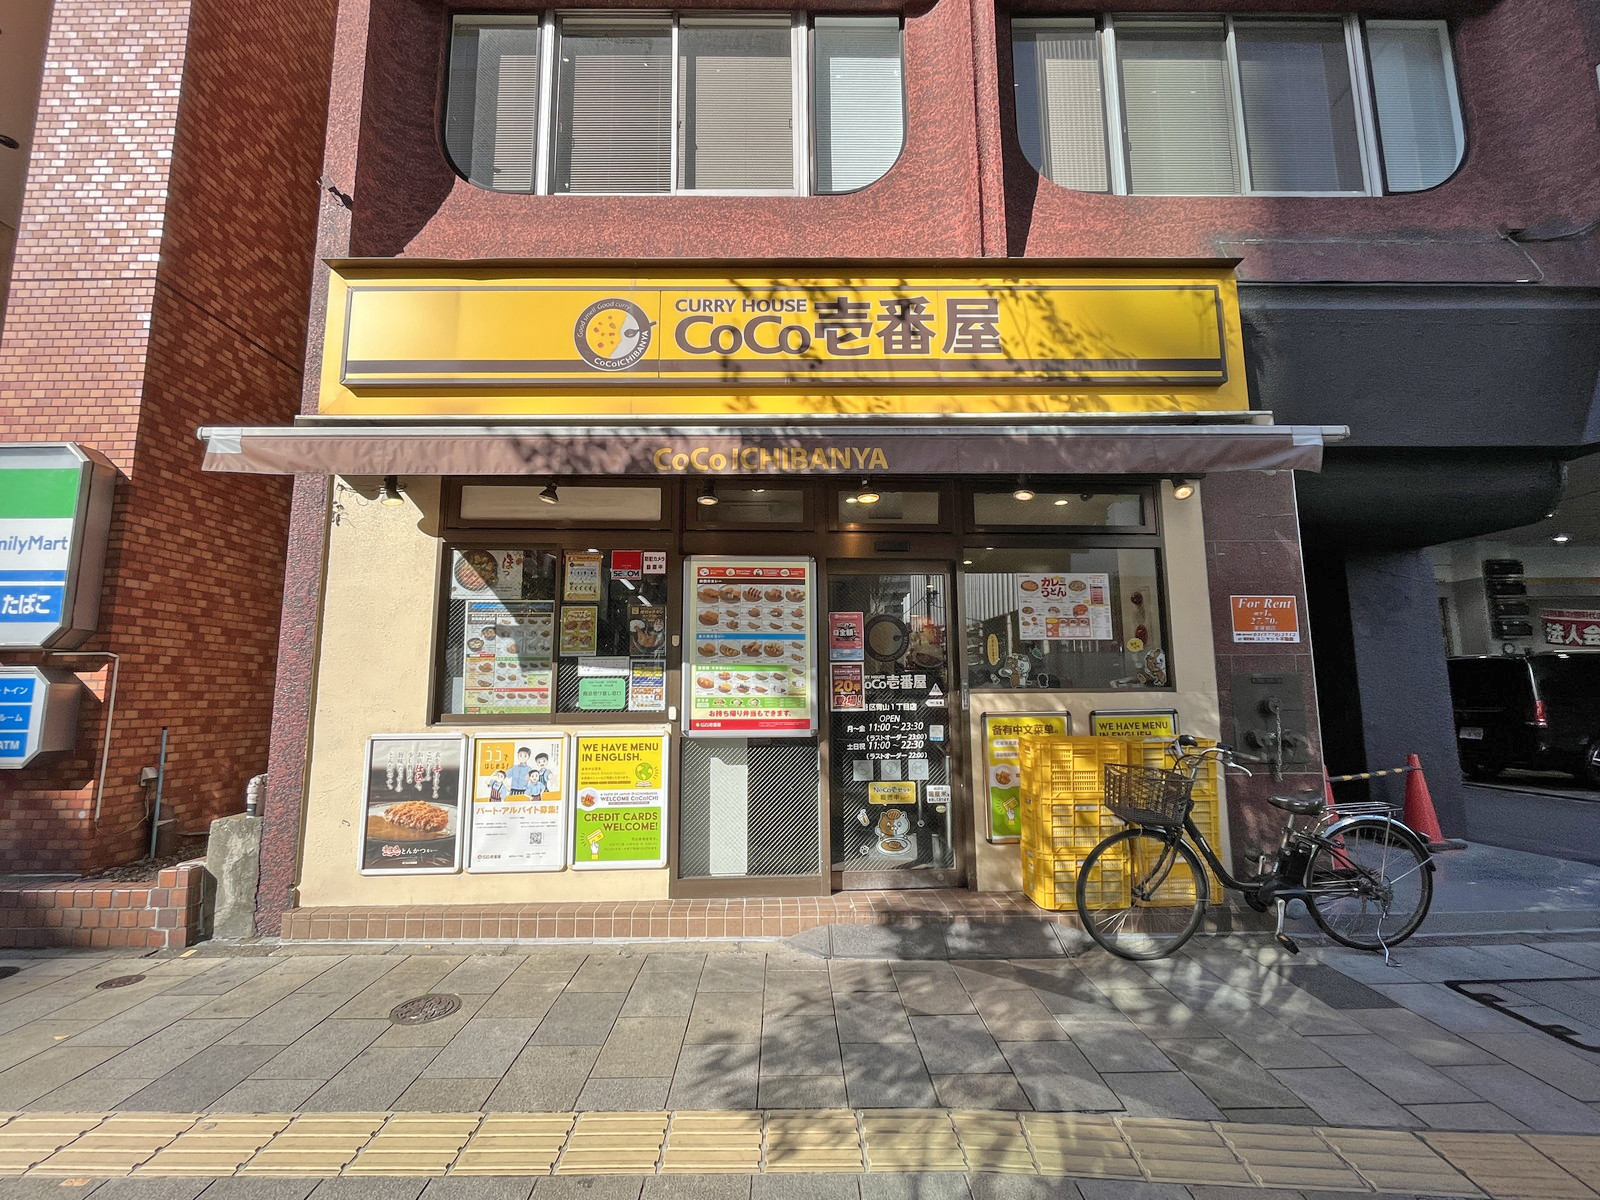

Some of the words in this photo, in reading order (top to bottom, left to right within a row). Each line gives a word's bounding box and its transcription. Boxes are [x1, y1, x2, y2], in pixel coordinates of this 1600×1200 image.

[675, 299, 737, 313] CURRY
[742, 299, 807, 313] HOUSE
[577, 321, 586, 338] Good
[597, 301, 615, 311] Good
[615, 302, 632, 311] curry
[673, 296, 1003, 356] CoCo壱番屋
[654, 447, 723, 473] CoCo
[731, 446, 889, 472] ICHIBANYA
[1041, 576, 1067, 587] カレー
[1041, 587, 1067, 598] うどん
[2, 593, 52, 615] たばこ
[1239, 598, 1261, 609] For
[1264, 598, 1292, 609] Rent
[865, 674, 928, 690] oCo壱番屋
[0, 686, 29, 696] トイン
[865, 703, 918, 711] 区青山1丁目店
[879, 715, 901, 723] OPEN
[868, 723, 891, 732] 11:00
[900, 722, 924, 731] 23:30
[992, 724, 1059, 736] 备有中文菜单。
[1098, 722, 1114, 731] WE
[1116, 721, 1140, 730] HAVE
[1142, 721, 1168, 730] MENU
[0, 740, 20, 750] ATM
[582, 744, 599, 752] WE
[601, 743, 628, 752] HAVE
[630, 743, 659, 751] MENU
[868, 741, 891, 750] 11:00
[900, 740, 924, 749] 22:30
[582, 754, 593, 762] IN
[595, 753, 642, 762] ENGLISH.
[584, 813, 621, 822] CREDIT
[622, 812, 658, 821] CARDS
[603, 822, 658, 831] WELCOME!
